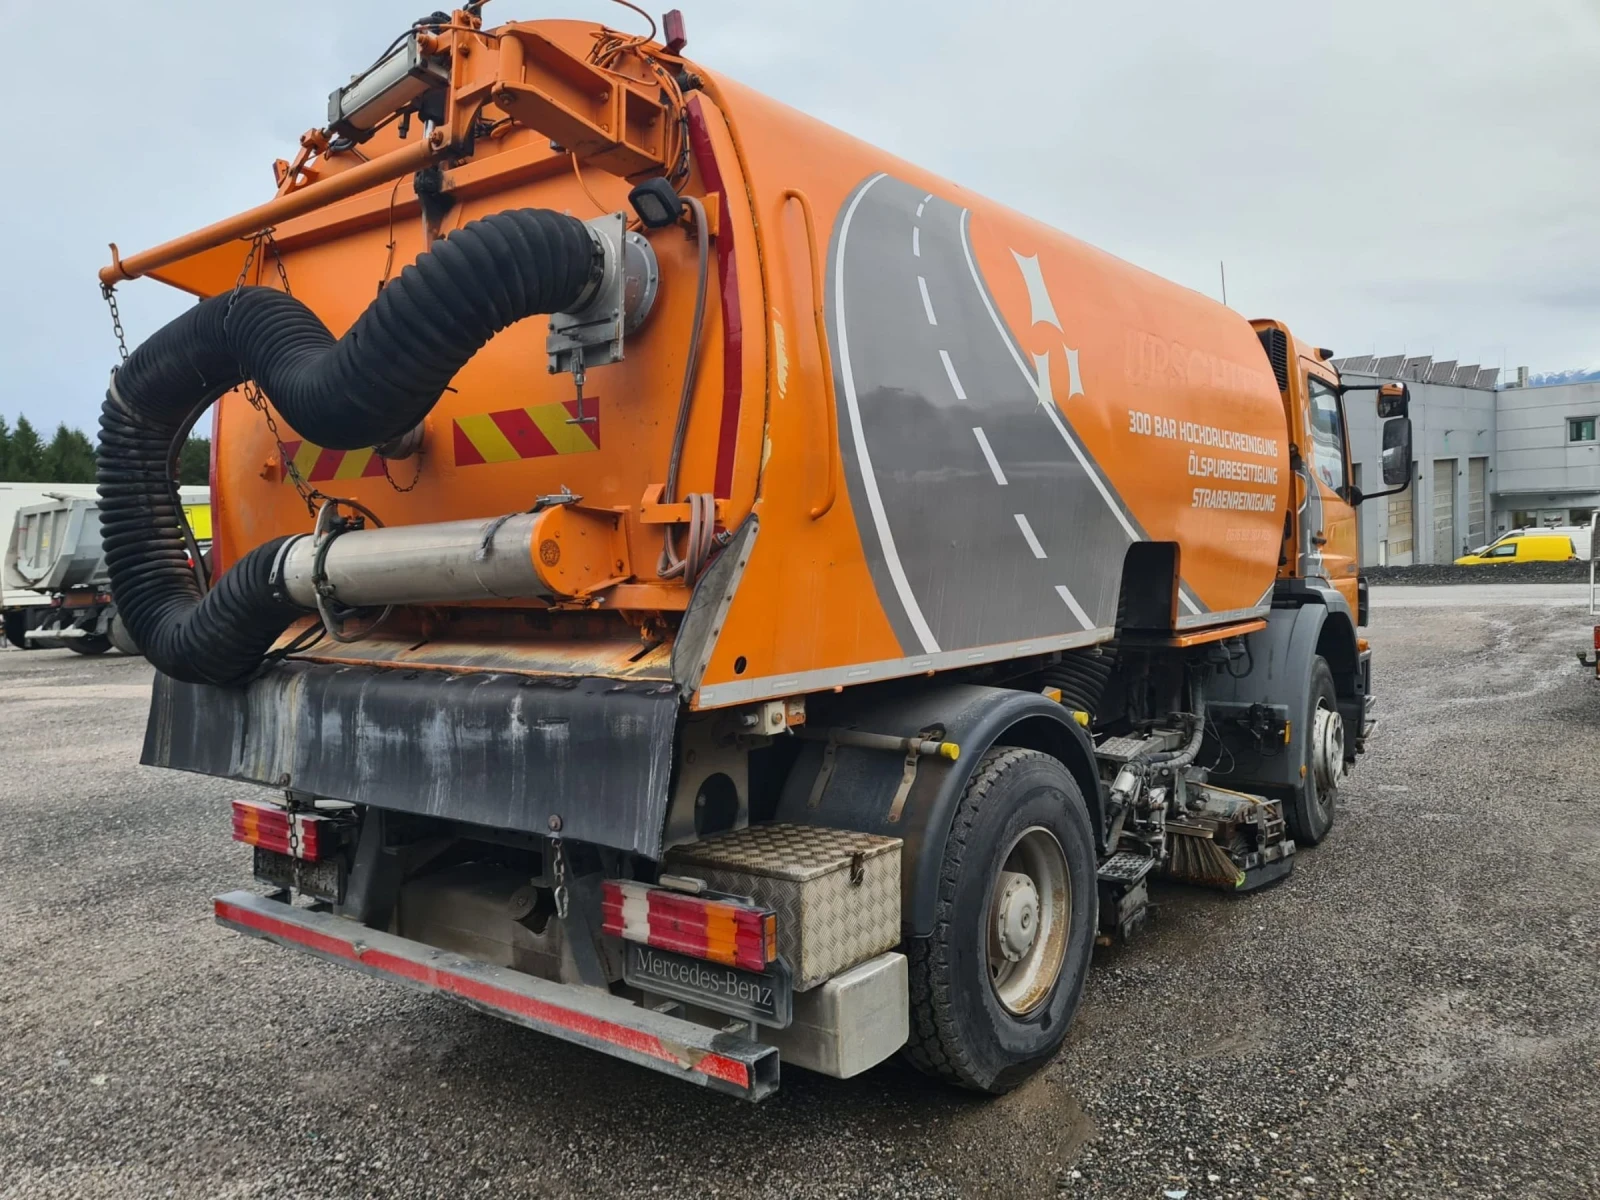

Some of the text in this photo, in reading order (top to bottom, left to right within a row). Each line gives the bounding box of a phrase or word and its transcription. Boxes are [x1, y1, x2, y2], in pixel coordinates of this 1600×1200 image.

[1128, 410, 1278, 457] 300 BAR HOCHDRUCKREINIGUNG
[1188, 449, 1278, 485] ÖLSPURBESEITIGUNG
[636, 948, 773, 1007] Mercedes-Benz
